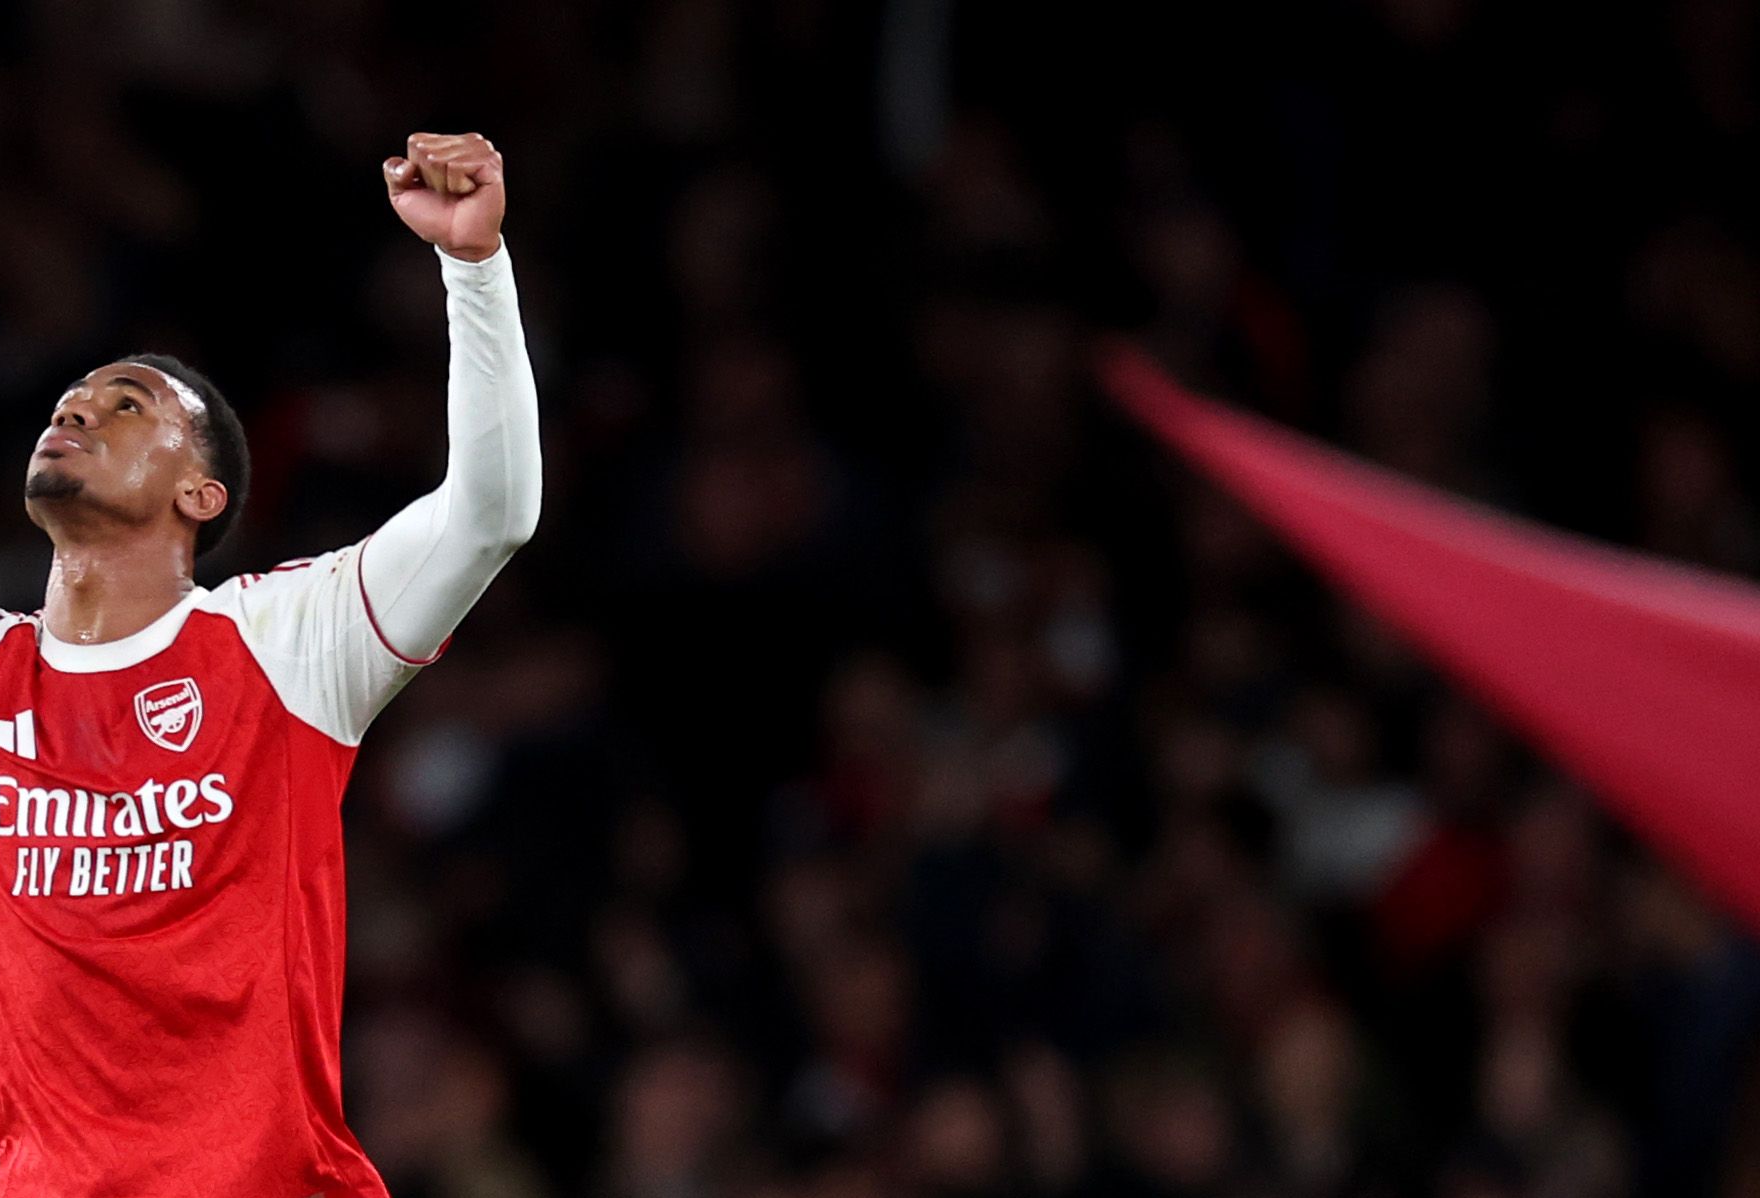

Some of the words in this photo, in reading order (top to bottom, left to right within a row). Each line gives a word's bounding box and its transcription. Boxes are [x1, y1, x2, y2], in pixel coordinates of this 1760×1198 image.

[146, 687, 192, 713] Arsenal
[11, 847, 61, 896] FLY
[69, 840, 193, 896] BETTER
